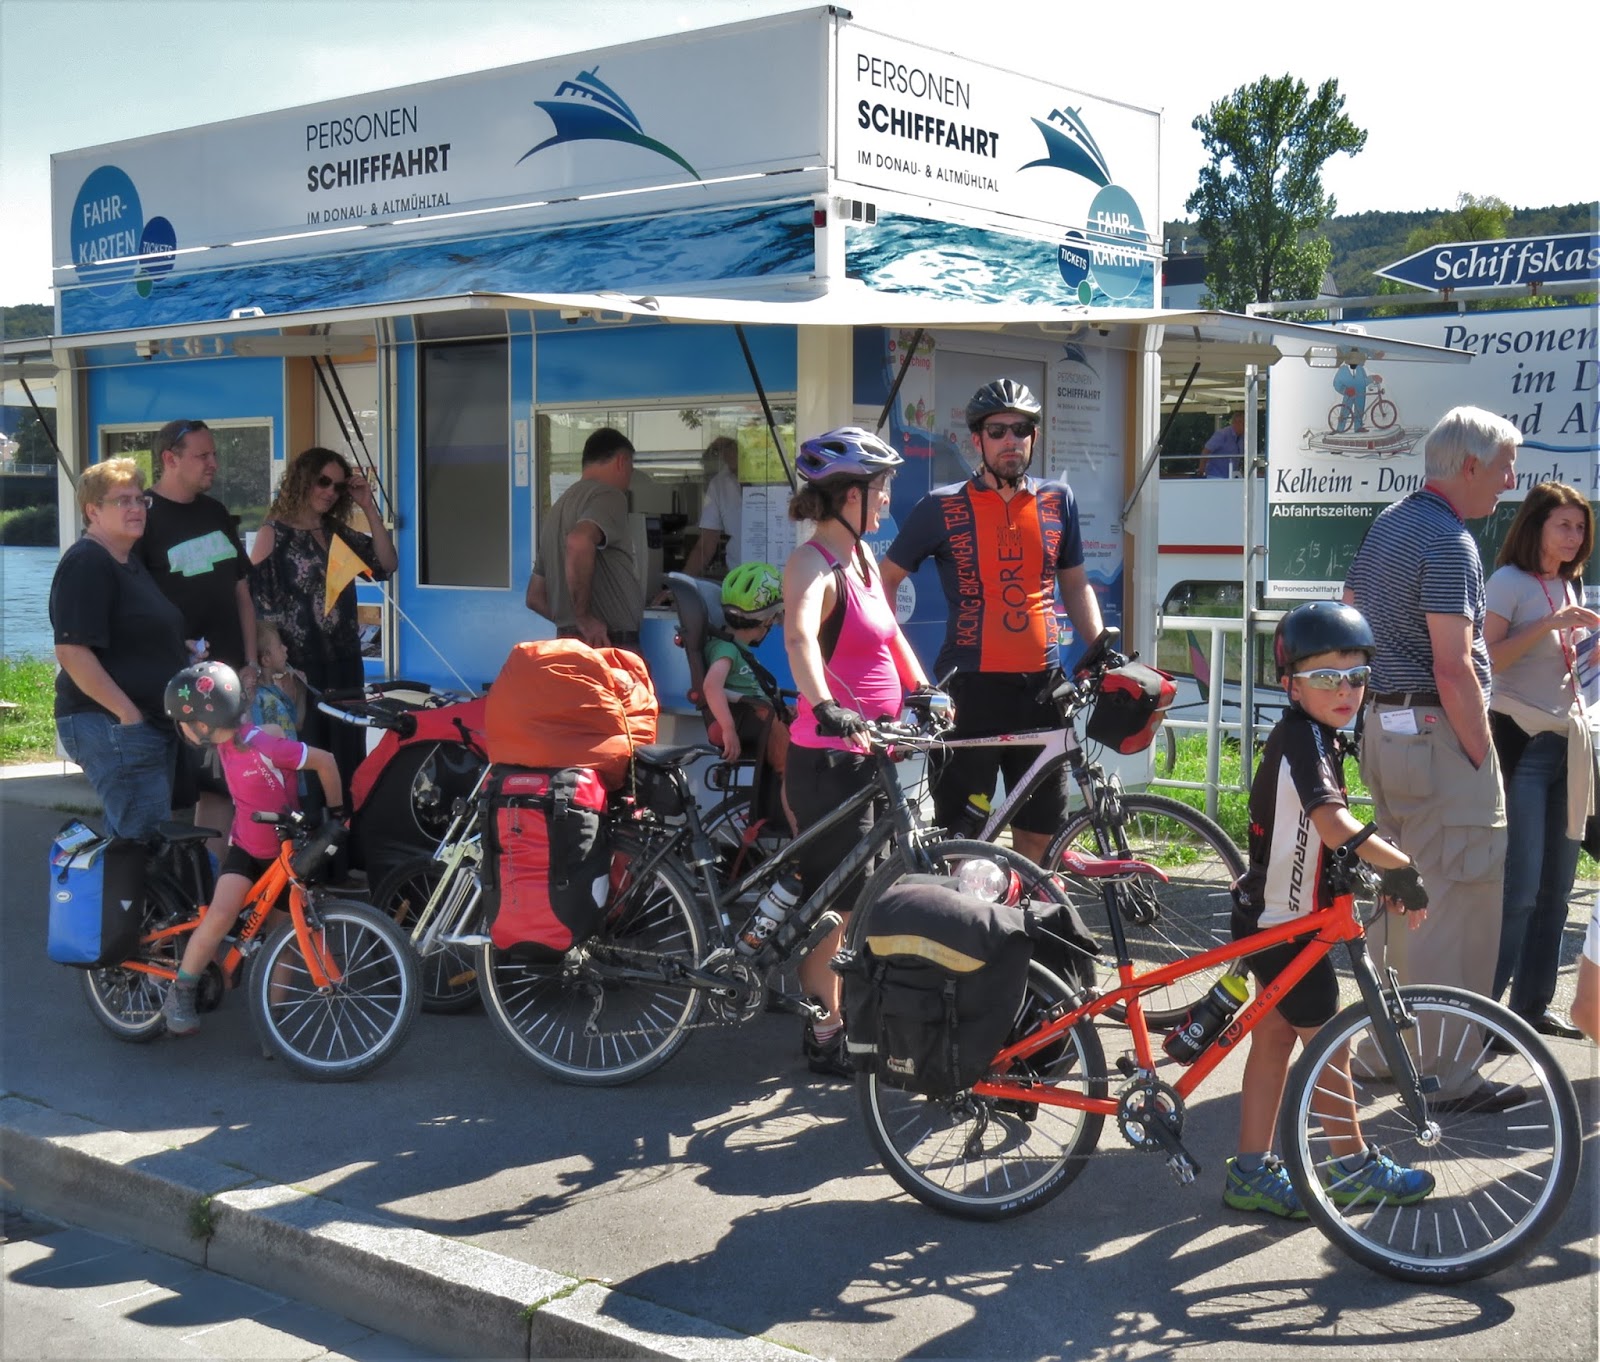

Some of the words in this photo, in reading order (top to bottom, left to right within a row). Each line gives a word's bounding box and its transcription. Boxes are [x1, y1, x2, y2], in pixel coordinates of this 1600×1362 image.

[857, 53, 970, 110] PERSONEN
[306, 105, 418, 151] PERSONEN
[858, 100, 999, 158] SCHIFFFAHRT
[307, 143, 451, 192] SCHIFFFAHRT
[857, 150, 872, 166] IM
[876, 154, 921, 176] DONAU-
[925, 165, 932, 178] &
[936, 167, 999, 192] ALTMÜHLTAL
[83, 194, 127, 228] FAHR-
[307, 211, 320, 225] IM
[323, 205, 367, 222] DONAU-
[371, 202, 378, 216] &
[382, 192, 451, 215] ALTMÜHLTAL
[80, 229, 136, 264] KARTEN
[1061, 248, 1087, 270] TICKETS
[1434, 240, 1600, 286] Schiffskas
[1444, 325, 1599, 355] Personen
[1057, 371, 1093, 386] PERSONEN
[1057, 387, 1101, 401] SCHIFFFAHRT
[1511, 362, 1556, 394] im
[1275, 468, 1352, 493] Kelheim
[940, 494, 970, 531] TEAM
[1042, 491, 1061, 524] TEAM
[1272, 504, 1372, 517] Abfahrtszeiten:
[949, 531, 979, 597] BIKEWEAR
[998, 547, 1030, 633] GORE
[957, 598, 981, 646] RACING
[1048, 815, 1087, 858] SCHWAL
[1288, 810, 1310, 912] SERIOUS
[240, 911, 262, 942] ANIA
[1244, 985, 1280, 1021] bikes
[1388, 1259, 1450, 1274] KOJAK
